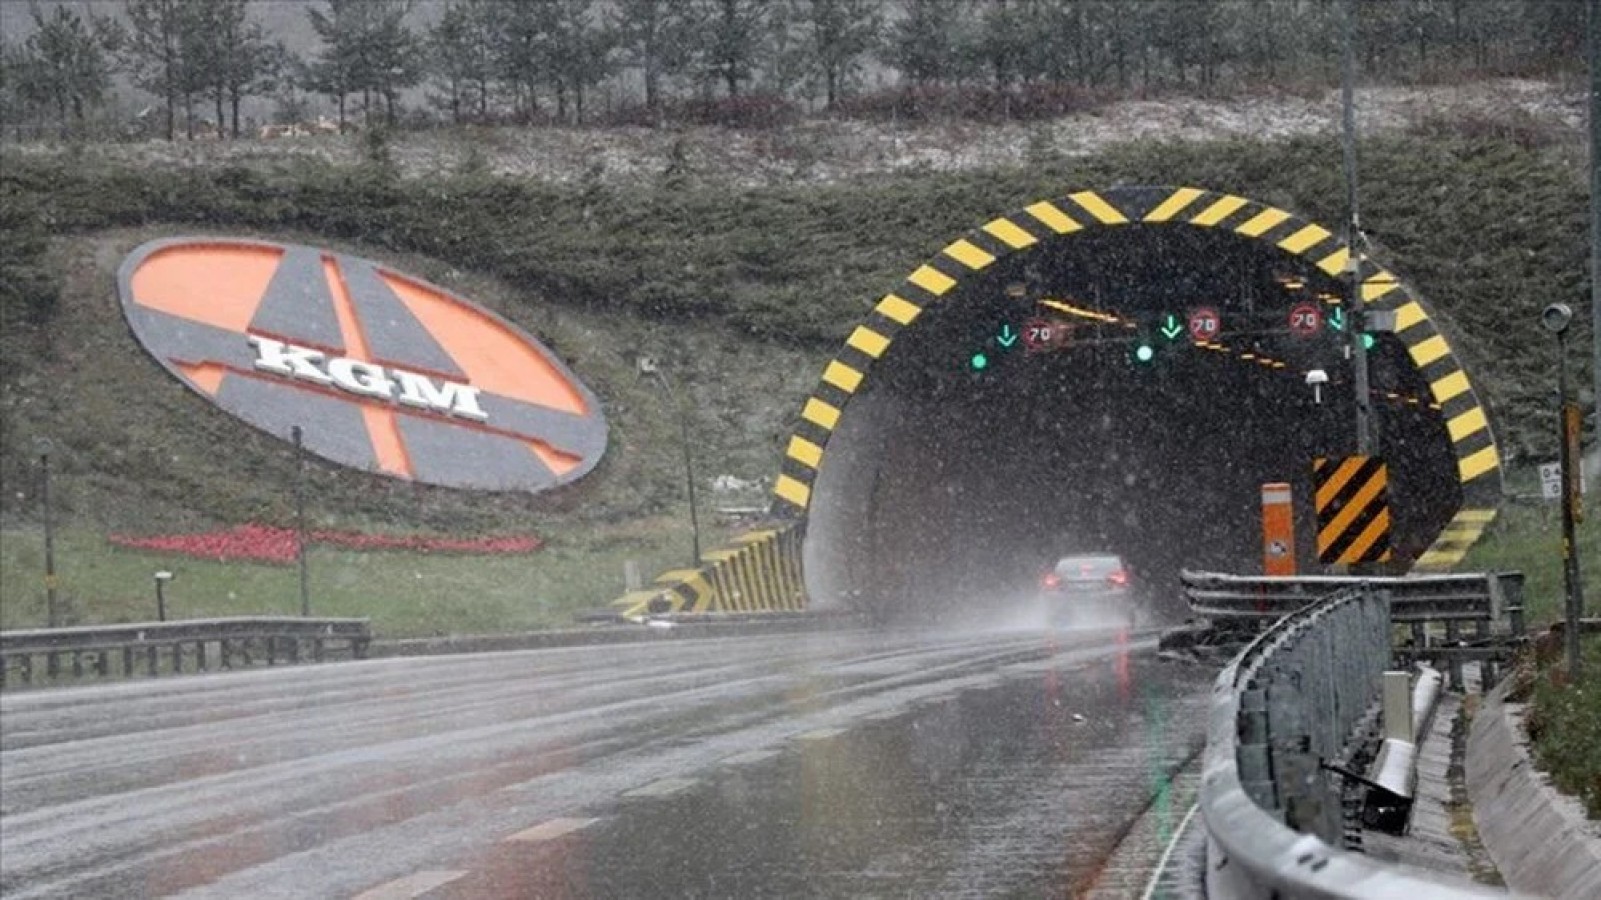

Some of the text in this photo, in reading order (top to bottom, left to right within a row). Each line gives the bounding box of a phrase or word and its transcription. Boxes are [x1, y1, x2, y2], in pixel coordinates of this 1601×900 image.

[1192, 318, 1216, 332] 70
[1292, 313, 1316, 327] 70
[1030, 328, 1050, 341] 70
[248, 335, 489, 423] KGM
